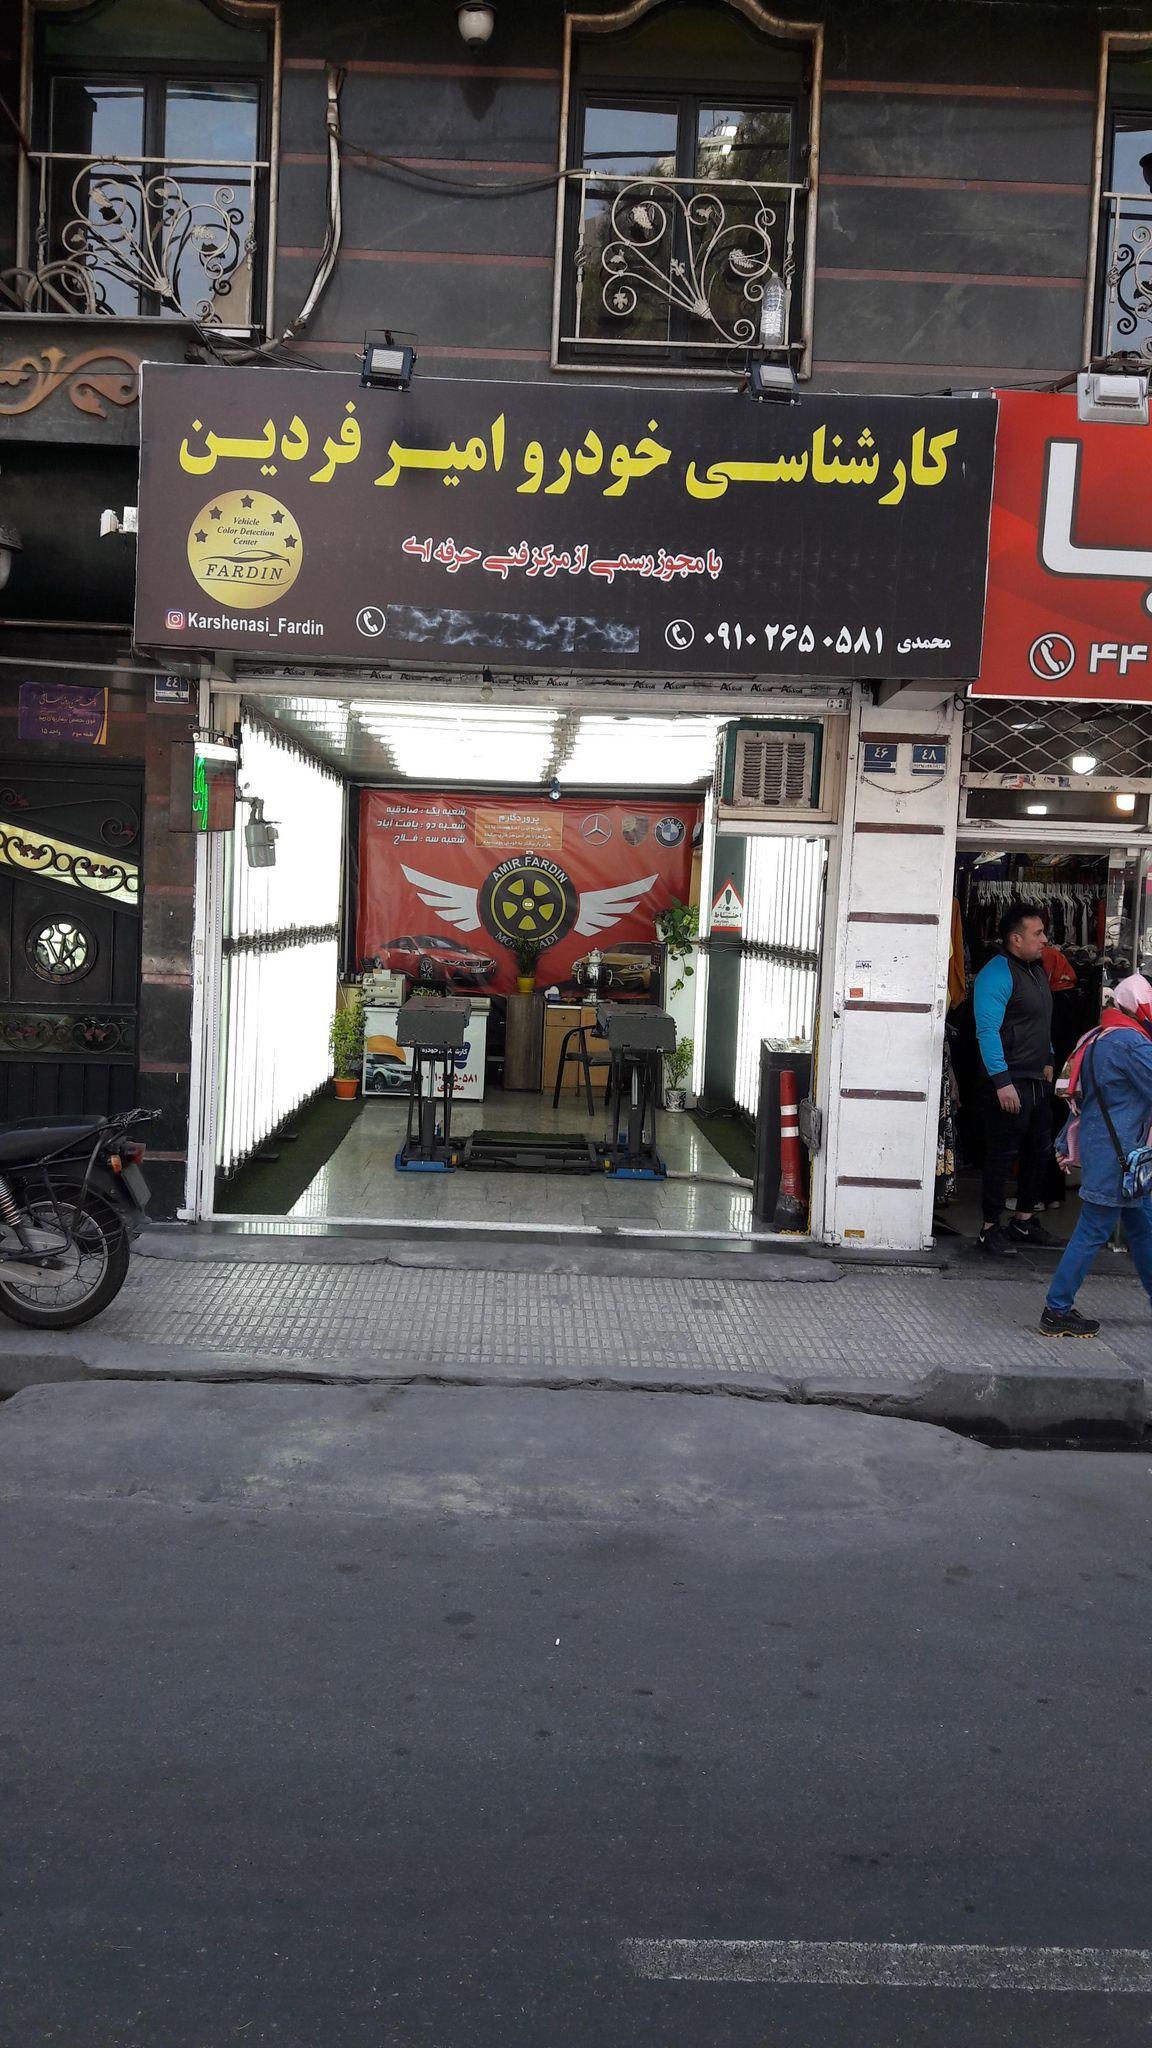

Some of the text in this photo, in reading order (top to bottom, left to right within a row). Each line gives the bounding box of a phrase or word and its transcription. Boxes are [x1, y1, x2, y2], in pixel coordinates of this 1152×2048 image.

[179, 400, 958, 505] کارشناسی خودرو امیر فردین
[233, 516, 260, 526] Vehicle
[217, 526, 275, 537] Color Detection
[233, 537, 258, 546] Center
[402, 535, 723, 584] با مجوز رسمی از مرکز فنی حرفه ای
[205, 563, 284, 580] FARDIN
[188, 612, 324, 637] Karshenasi_Fardin
[897, 636, 952, 654] محمدی
[386, 805, 418, 815] صادقیه
[425, 806, 441, 817] یک
[442, 806, 466, 816] شعبه
[395, 819, 419, 830] یافت
[425, 821, 437, 830] دو
[438, 819, 466, 831] شعبه
[393, 833, 419, 845] فلاح
[441, 834, 466, 845] شعبه
[492, 856, 568, 884] AMIR FARDIN
